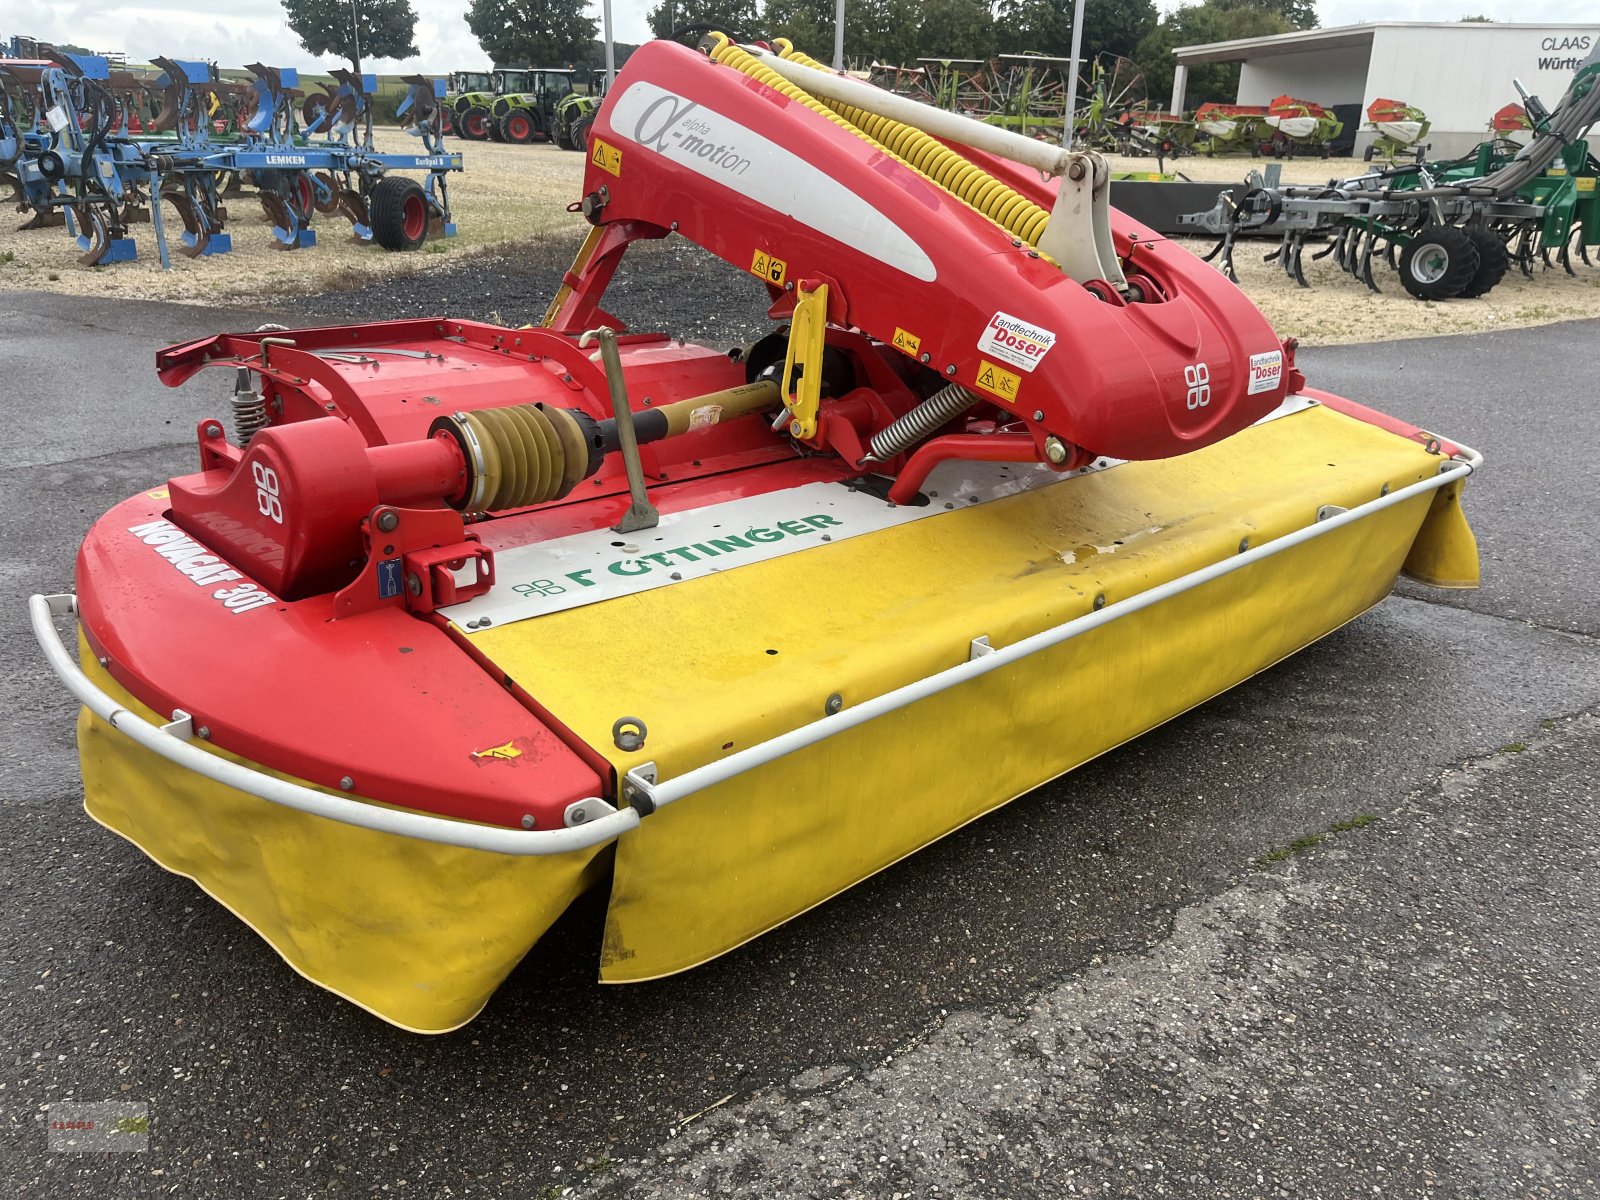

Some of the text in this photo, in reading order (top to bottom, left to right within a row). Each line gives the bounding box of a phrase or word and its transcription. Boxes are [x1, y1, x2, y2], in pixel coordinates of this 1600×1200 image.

[1541, 36, 1590, 50] CLAAS
[681, 118, 711, 135] alpha
[266, 155, 305, 165] LEMKEN
[989, 314, 1053, 346] Landtechnik
[993, 327, 1047, 358] Doser
[1256, 365, 1281, 379] Doser
[127, 520, 244, 586] NOVACAT
[212, 583, 277, 614] 301
